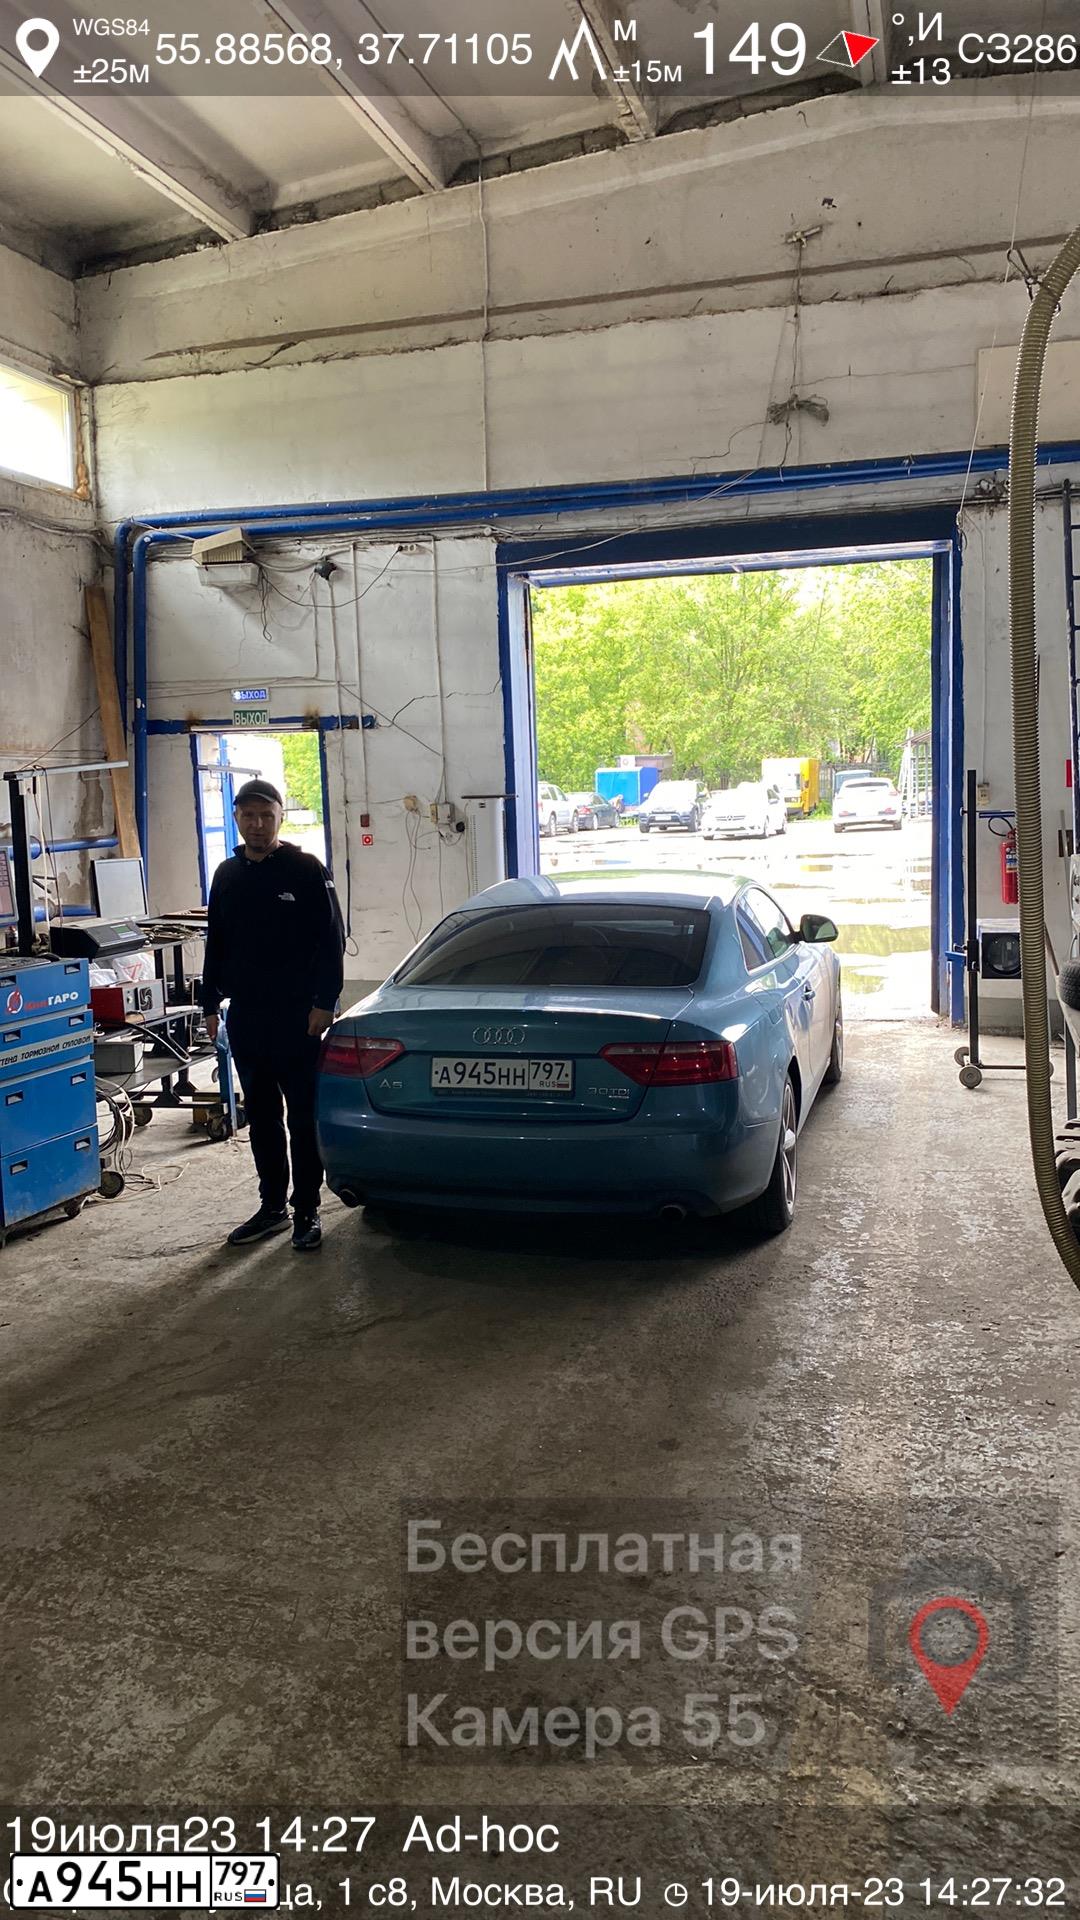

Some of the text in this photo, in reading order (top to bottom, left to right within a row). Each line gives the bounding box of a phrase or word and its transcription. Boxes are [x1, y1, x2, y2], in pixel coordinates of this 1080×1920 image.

[235, 712, 267, 725] ВЫХОД
[531, 1062, 565, 1080] 797
[379, 1078, 403, 1089] A5
